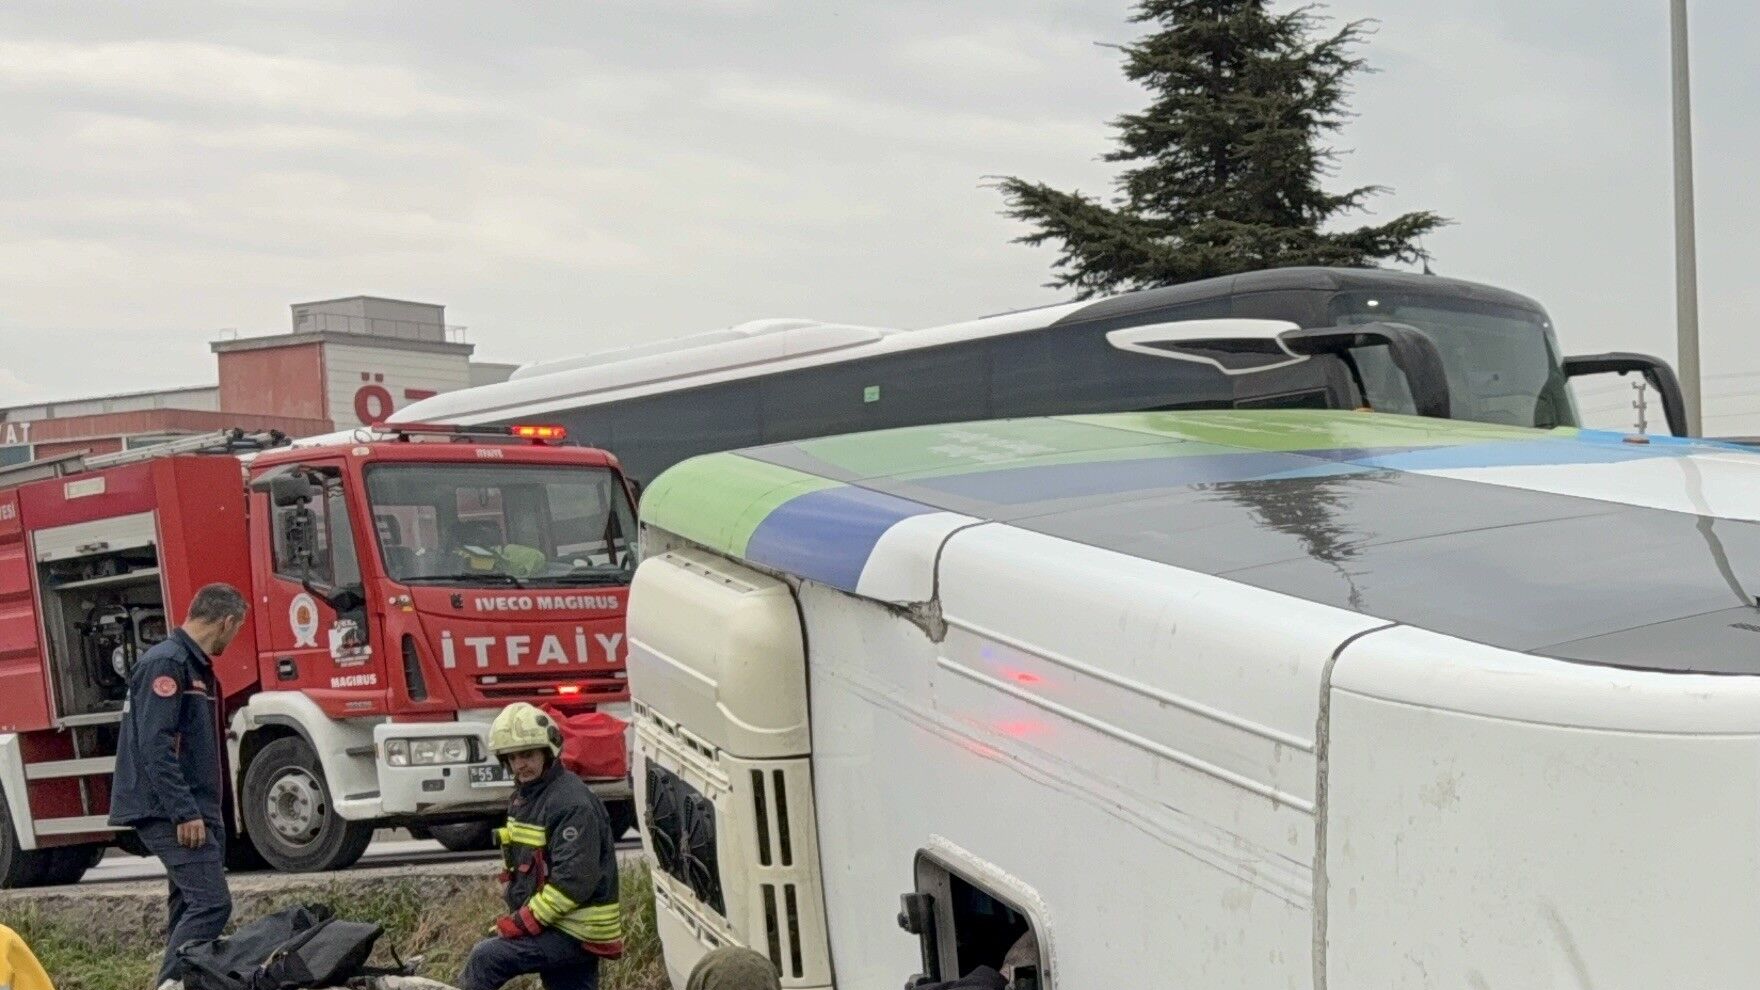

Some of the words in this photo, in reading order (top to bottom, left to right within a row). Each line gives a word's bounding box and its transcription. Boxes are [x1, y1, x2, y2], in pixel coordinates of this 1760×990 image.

[0, 422, 30, 445] AT
[475, 596, 533, 612] IVECO
[536, 595, 619, 611] MAGIRUS
[440, 626, 624, 669] İTFAİY
